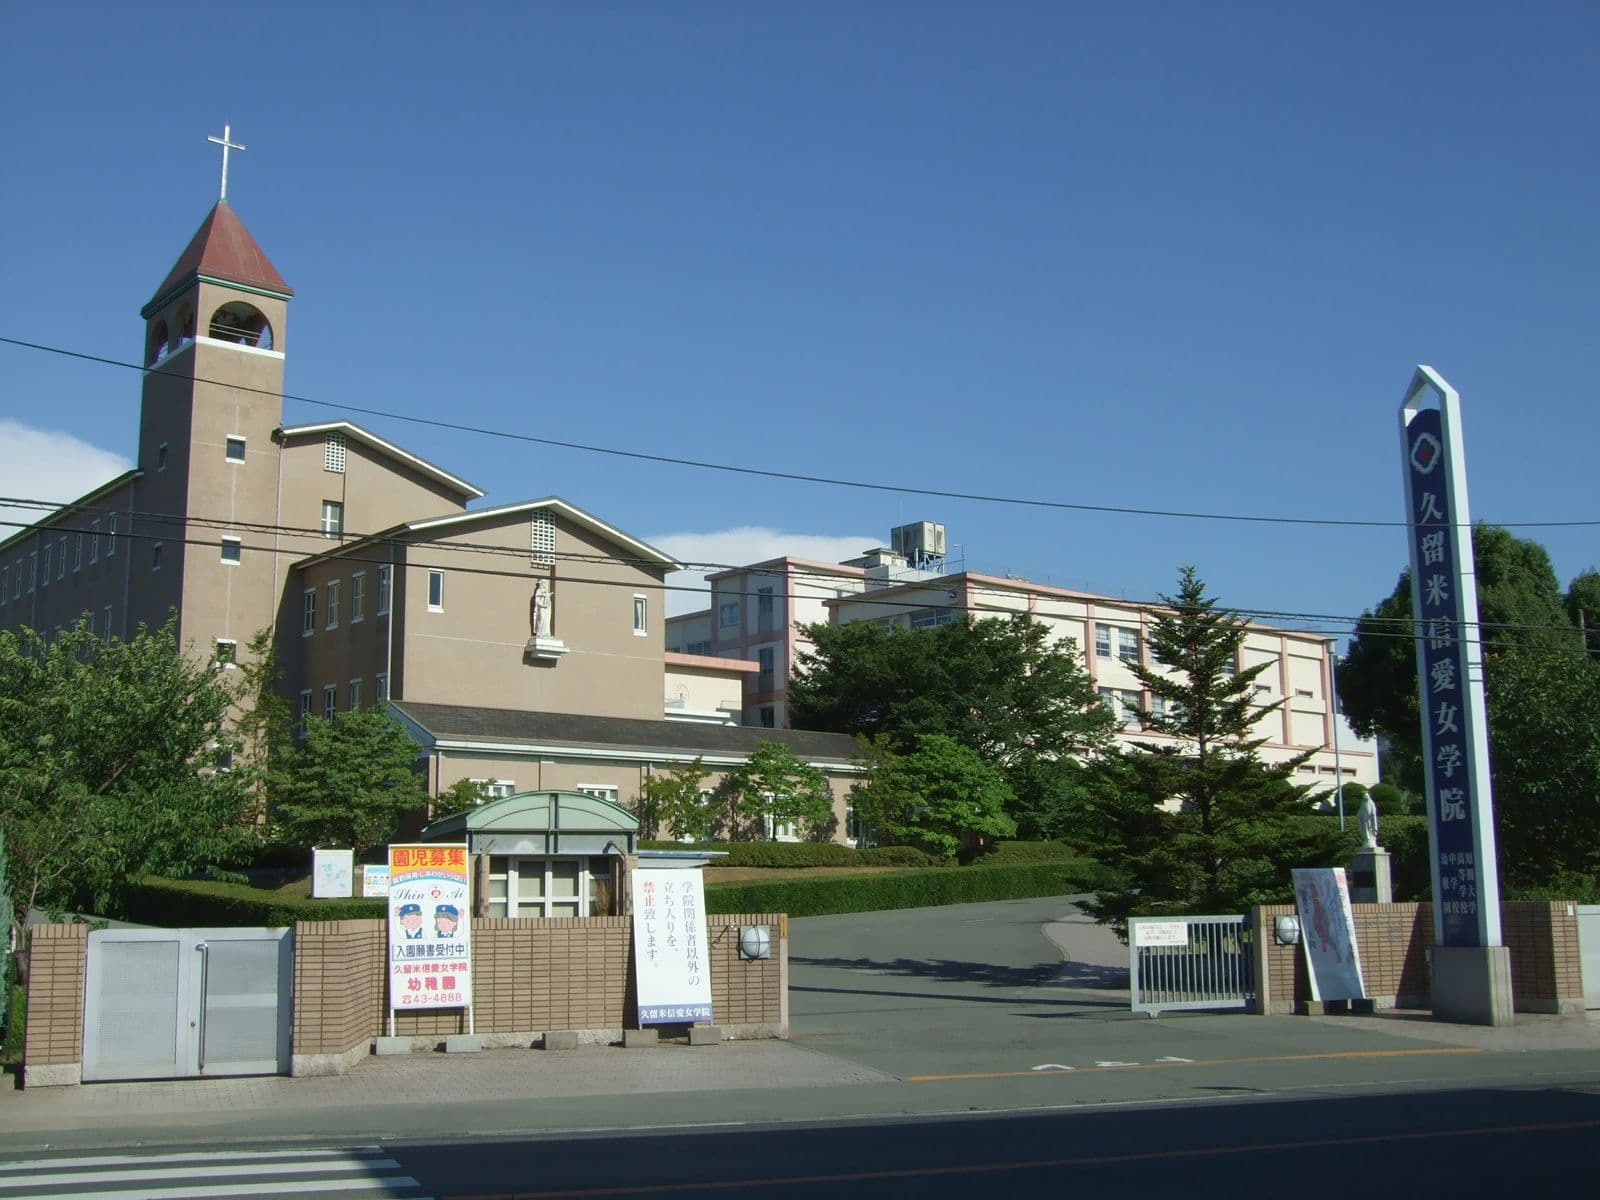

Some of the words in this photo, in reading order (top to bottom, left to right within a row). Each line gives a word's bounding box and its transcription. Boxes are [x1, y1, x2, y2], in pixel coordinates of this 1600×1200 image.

[1420, 492, 1466, 823] 久留米信愛女学院
[393, 848, 465, 867] 園児募集
[393, 887, 425, 900] Shin
[643, 880, 659, 968] 禁止致します。
[664, 880, 679, 952] 立ち入りを、
[681, 880, 700, 986] 学院関係者以外の
[396, 943, 465, 957] 入園願書受付中
[394, 962, 468, 975] 久留米信愛女学院
[407, 975, 456, 992] 幼稚園
[413, 992, 463, 1003] 43-4888
[640, 1006, 711, 1019] 久留米信愛女学院
